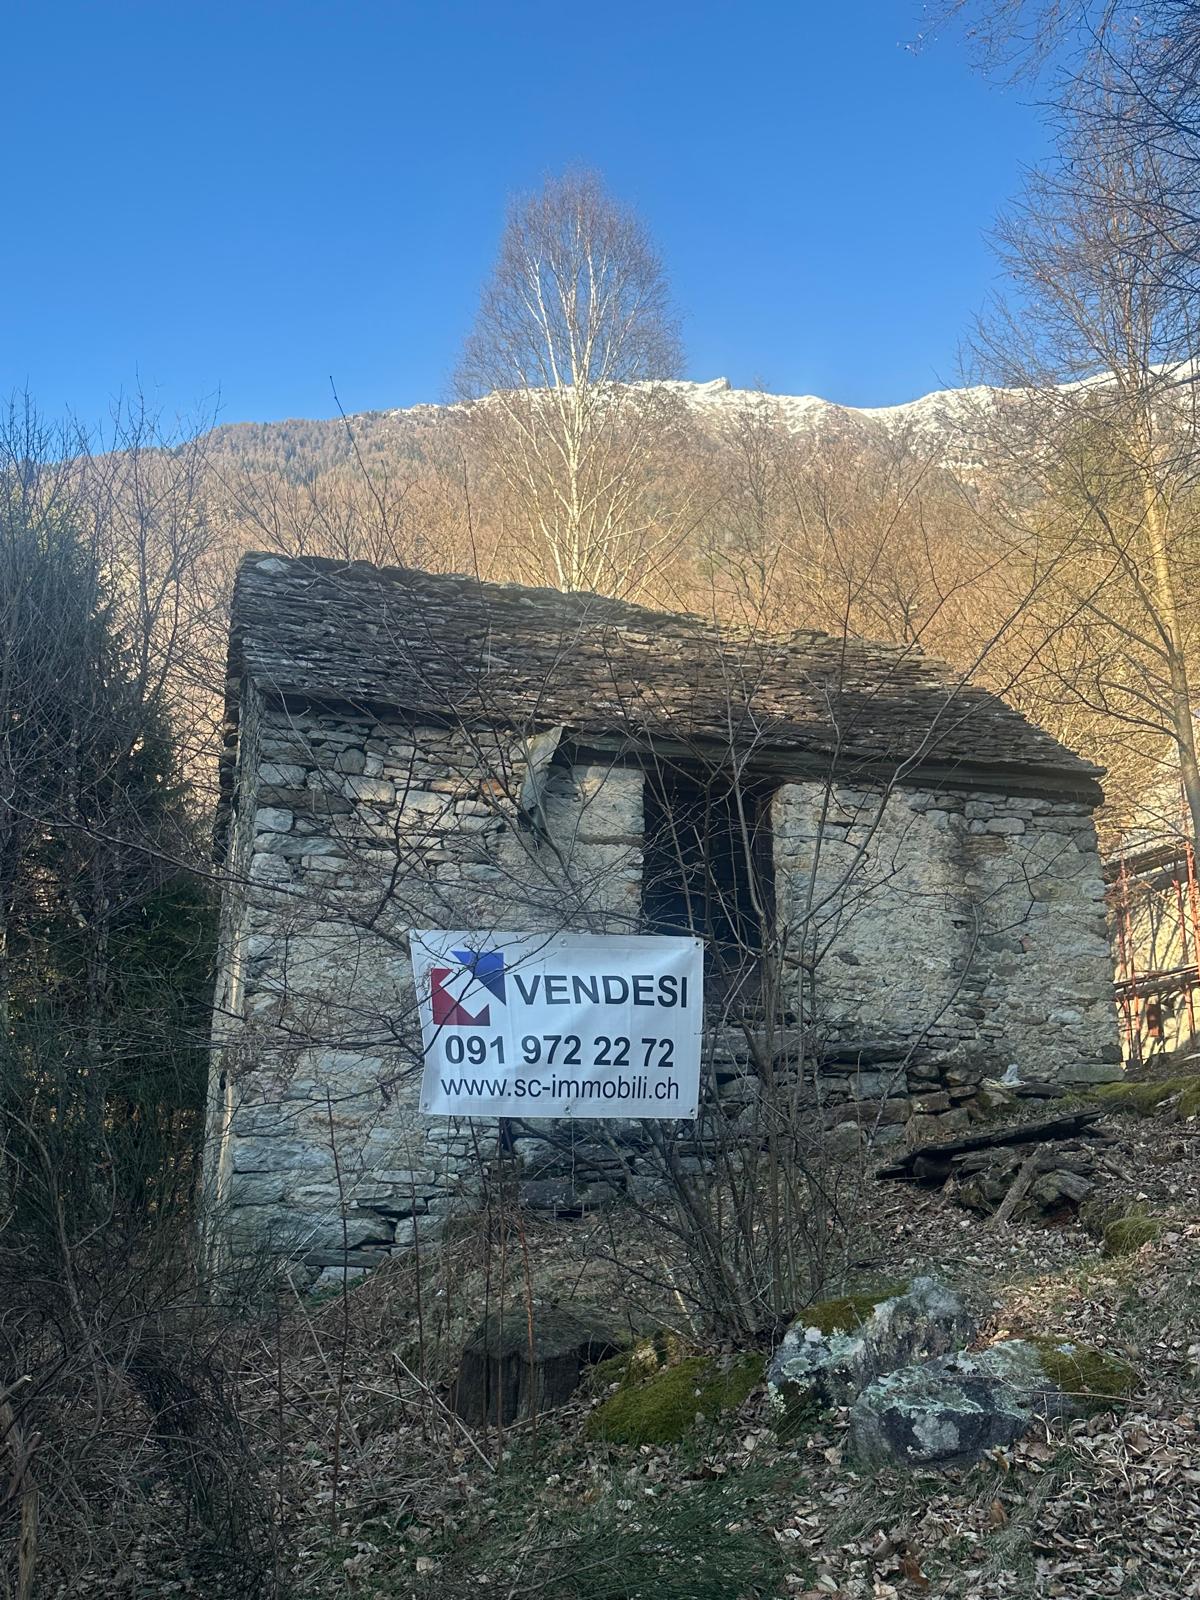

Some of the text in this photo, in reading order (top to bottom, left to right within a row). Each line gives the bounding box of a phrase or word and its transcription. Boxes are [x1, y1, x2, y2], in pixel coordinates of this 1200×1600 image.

[513, 974, 688, 1008] VENDESI
[445, 1035, 675, 1068] 091 972 22 72
[440, 1075, 679, 1100] www.sc-immobili.ch
